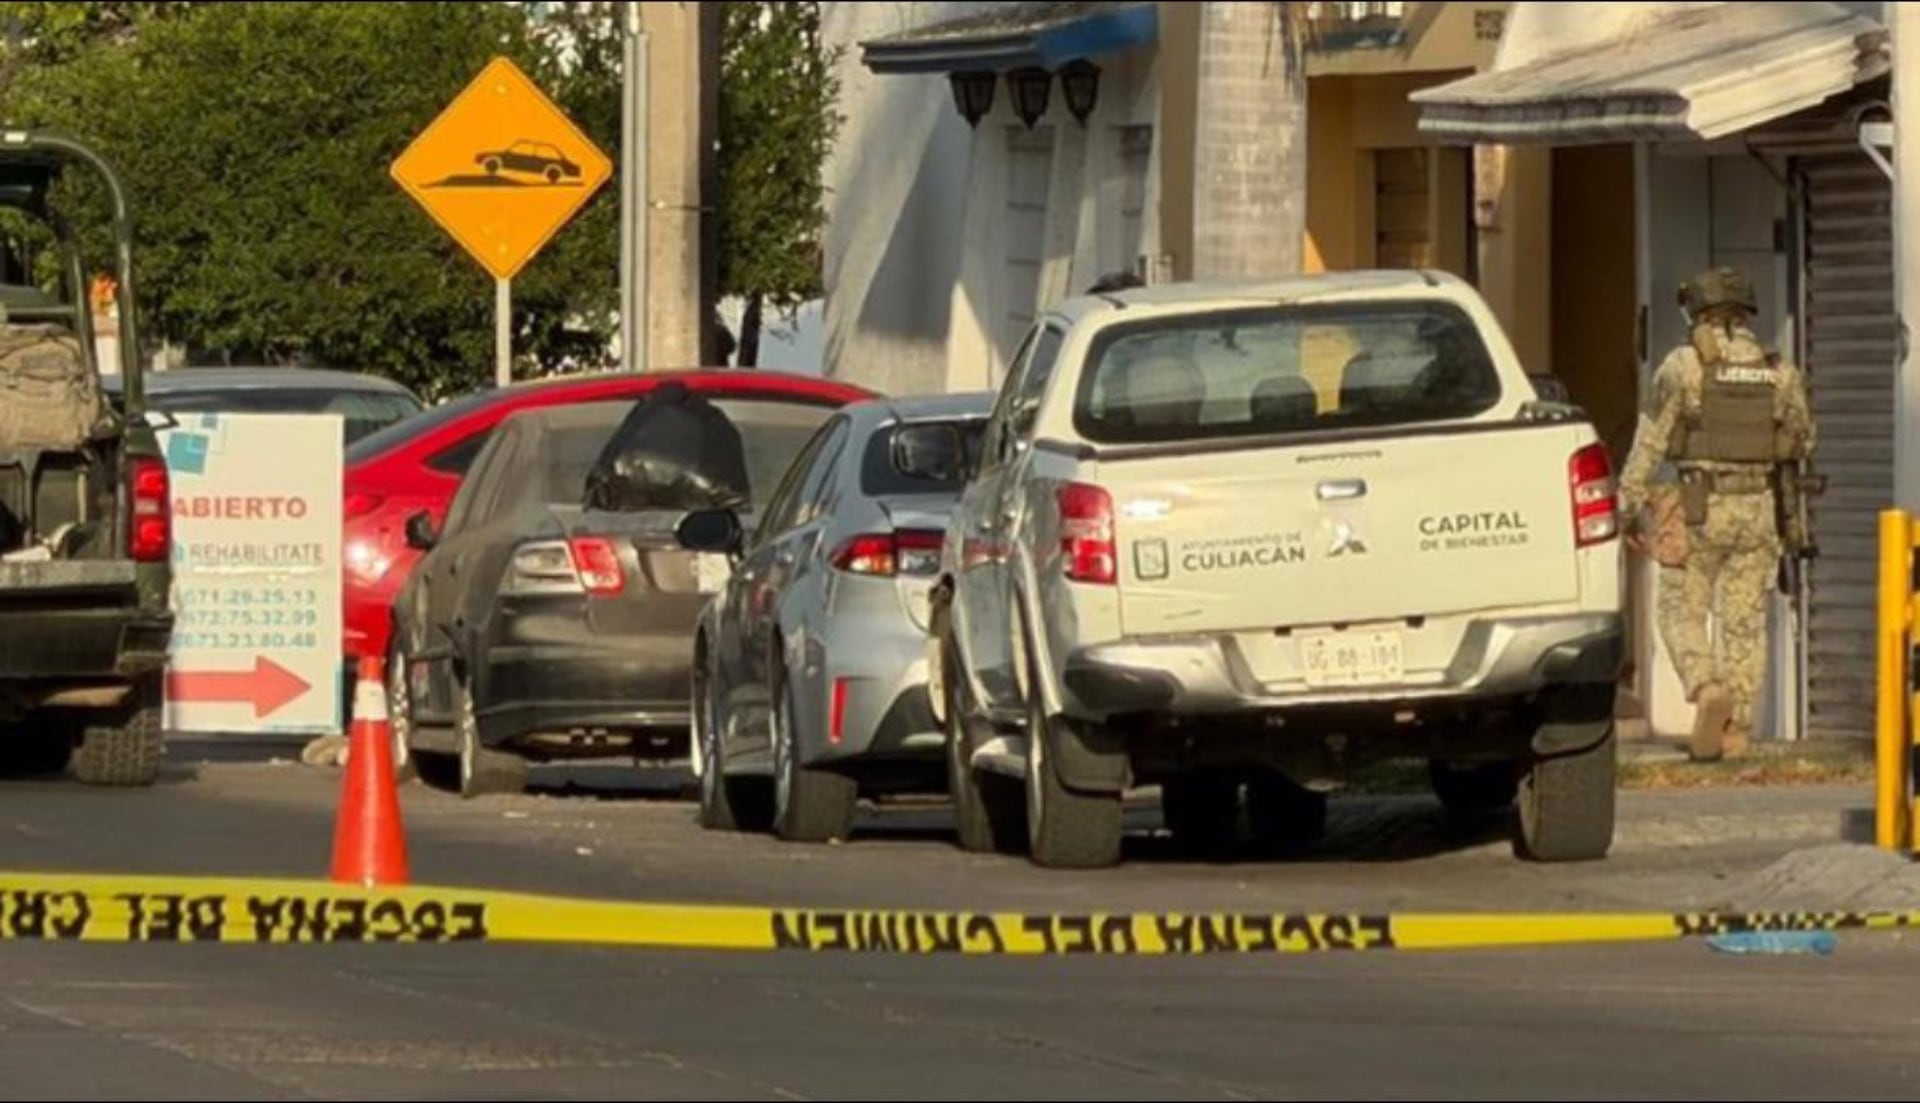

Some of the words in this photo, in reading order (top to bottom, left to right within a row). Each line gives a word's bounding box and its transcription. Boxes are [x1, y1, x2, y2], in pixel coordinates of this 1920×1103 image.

[174, 496, 307, 519] ABIERTO
[1419, 510, 1529, 536] CAPITAL
[189, 542, 324, 564] REHABILITATE
[1420, 538, 1439, 552] DE
[1445, 532, 1529, 550] BIENESTAR
[113, 892, 227, 941] DEL
[247, 895, 489, 942] ESCENA
[771, 909, 1006, 953] CRIMEN
[1022, 912, 1138, 953] DEL
[1154, 913, 1398, 951] ESCENA
